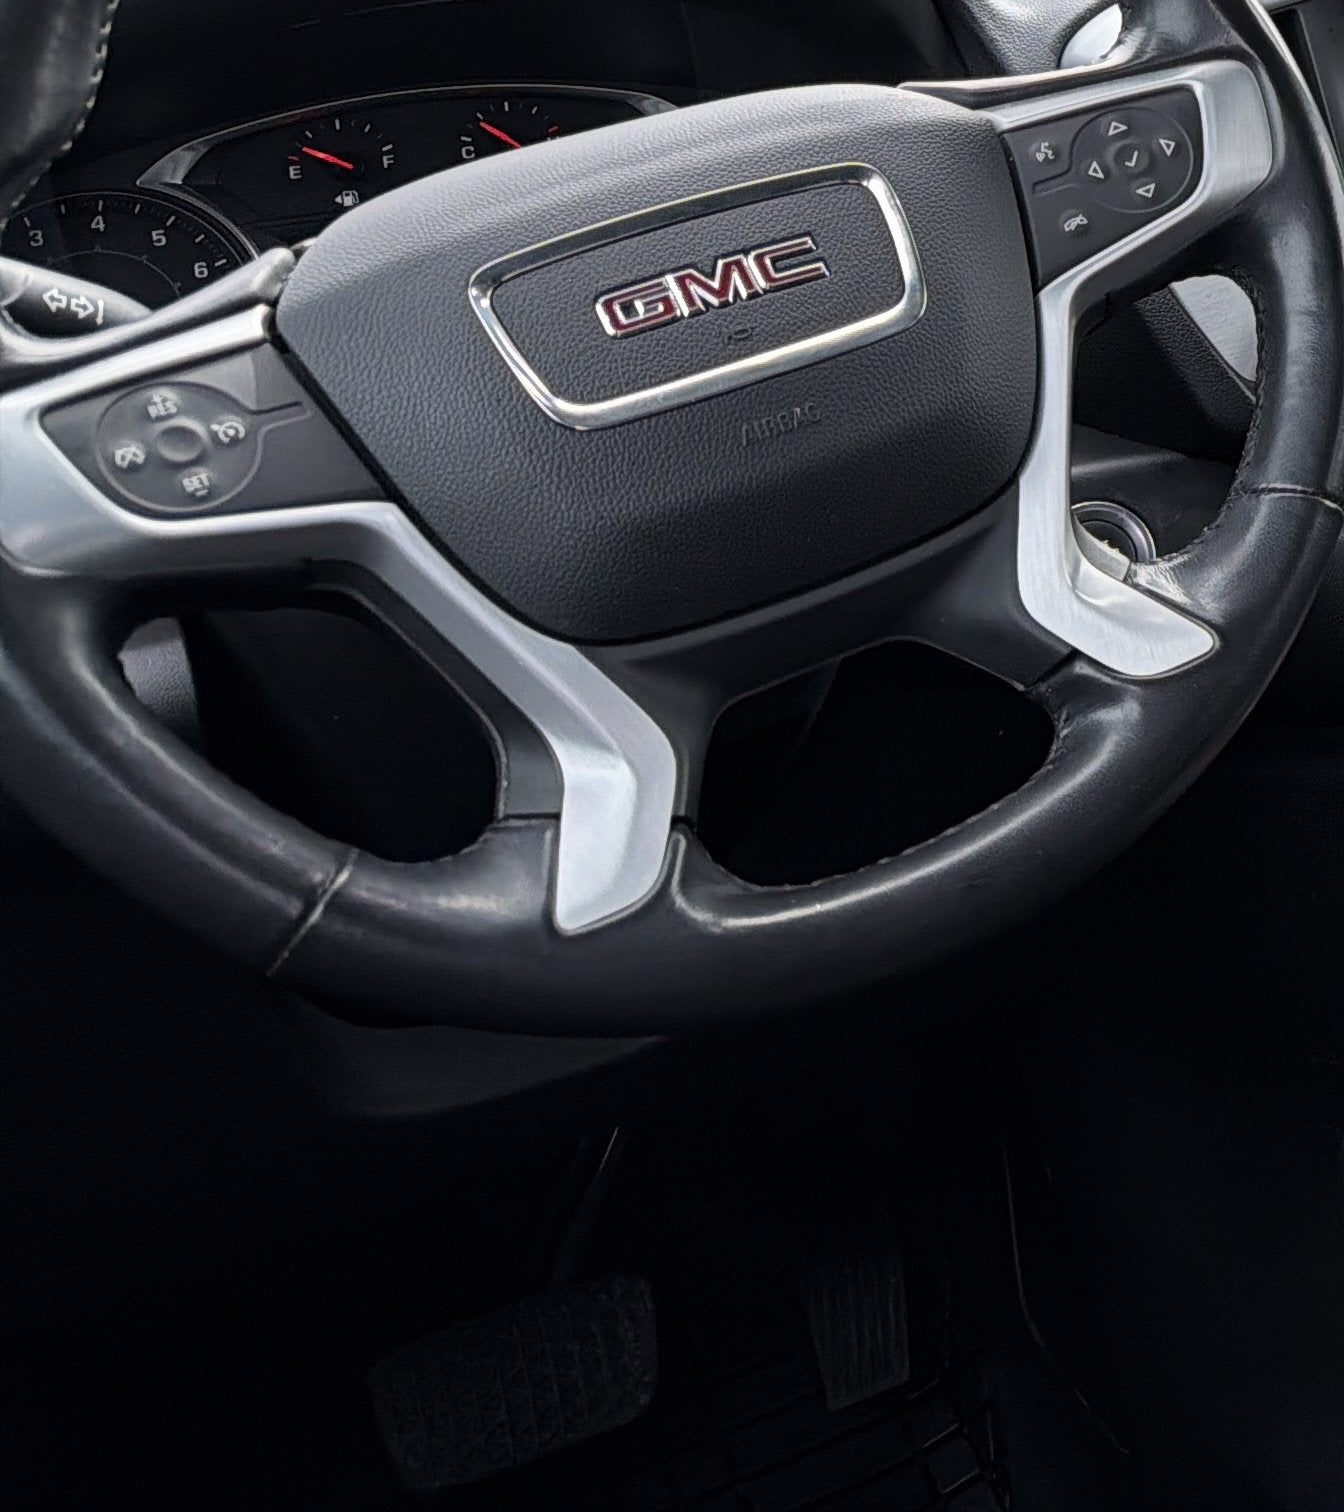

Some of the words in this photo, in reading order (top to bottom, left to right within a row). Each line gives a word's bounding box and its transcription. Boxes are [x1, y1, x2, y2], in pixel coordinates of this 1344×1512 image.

[461, 144, 475, 161] C
[382, 153, 395, 170] F
[289, 165, 302, 181] E
[90, 215, 106, 232] 4
[28, 230, 44, 248] 3
[151, 230, 167, 247] 5
[193, 262, 209, 279] 6
[595, 236, 831, 338] GMC
[740, 402, 825, 448] AIRBAG
